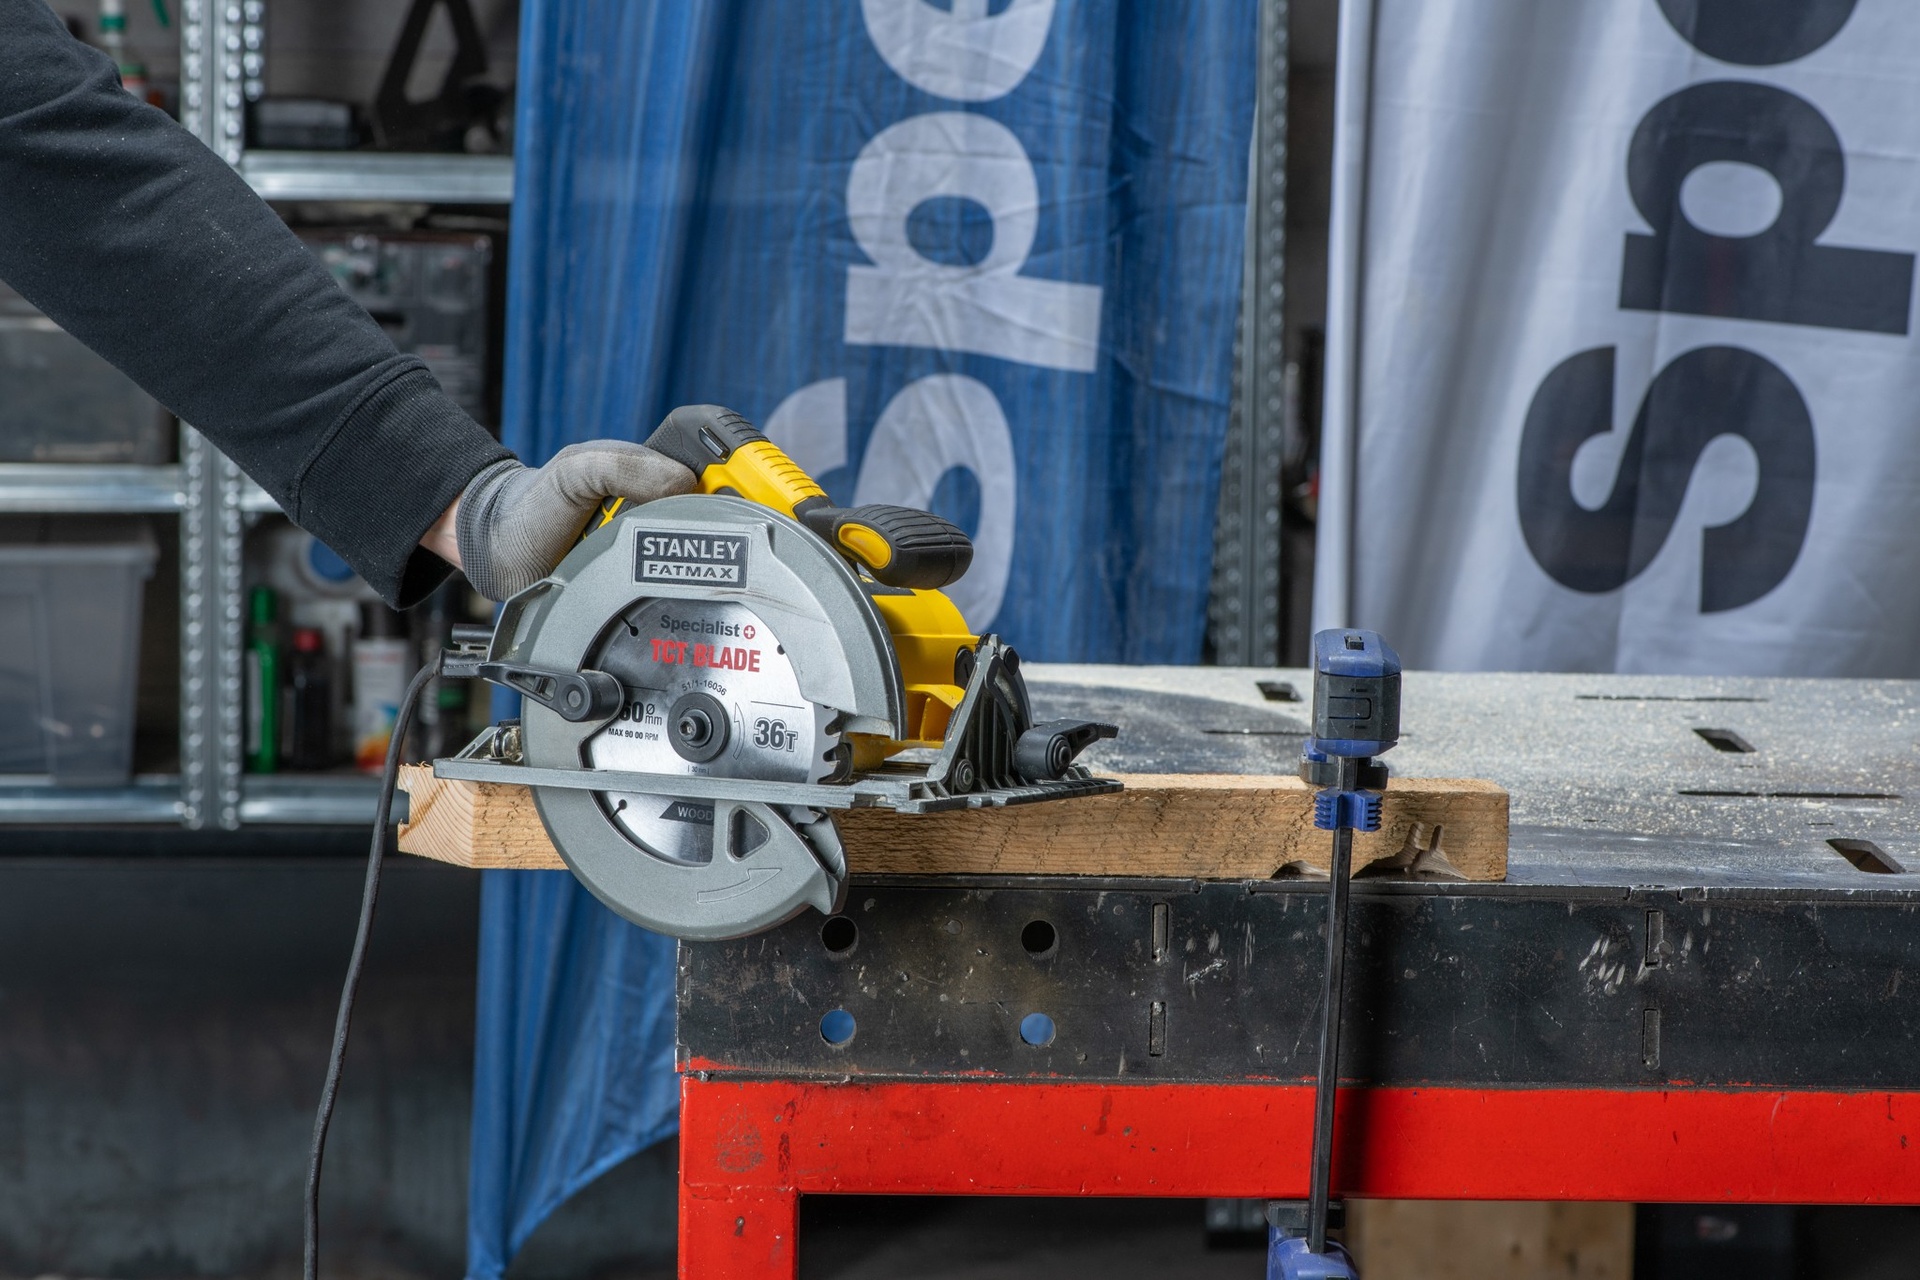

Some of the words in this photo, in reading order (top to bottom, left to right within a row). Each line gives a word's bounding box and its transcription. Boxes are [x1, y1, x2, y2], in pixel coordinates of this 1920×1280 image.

[1516, 0, 1916, 614] Sp
[642, 536, 741, 561] STANLEY
[648, 564, 733, 579] FATMAX
[660, 614, 740, 637] Specialist
[650, 638, 688, 665] TCT
[693, 643, 761, 673] BLADE
[681, 679, 727, 696] 51/1-16036
[608, 728, 624, 737] MAX
[625, 730, 634, 738] 90
[645, 732, 659, 741] RPM
[753, 717, 799, 753] 36T
[677, 805, 714, 821] WOOD
